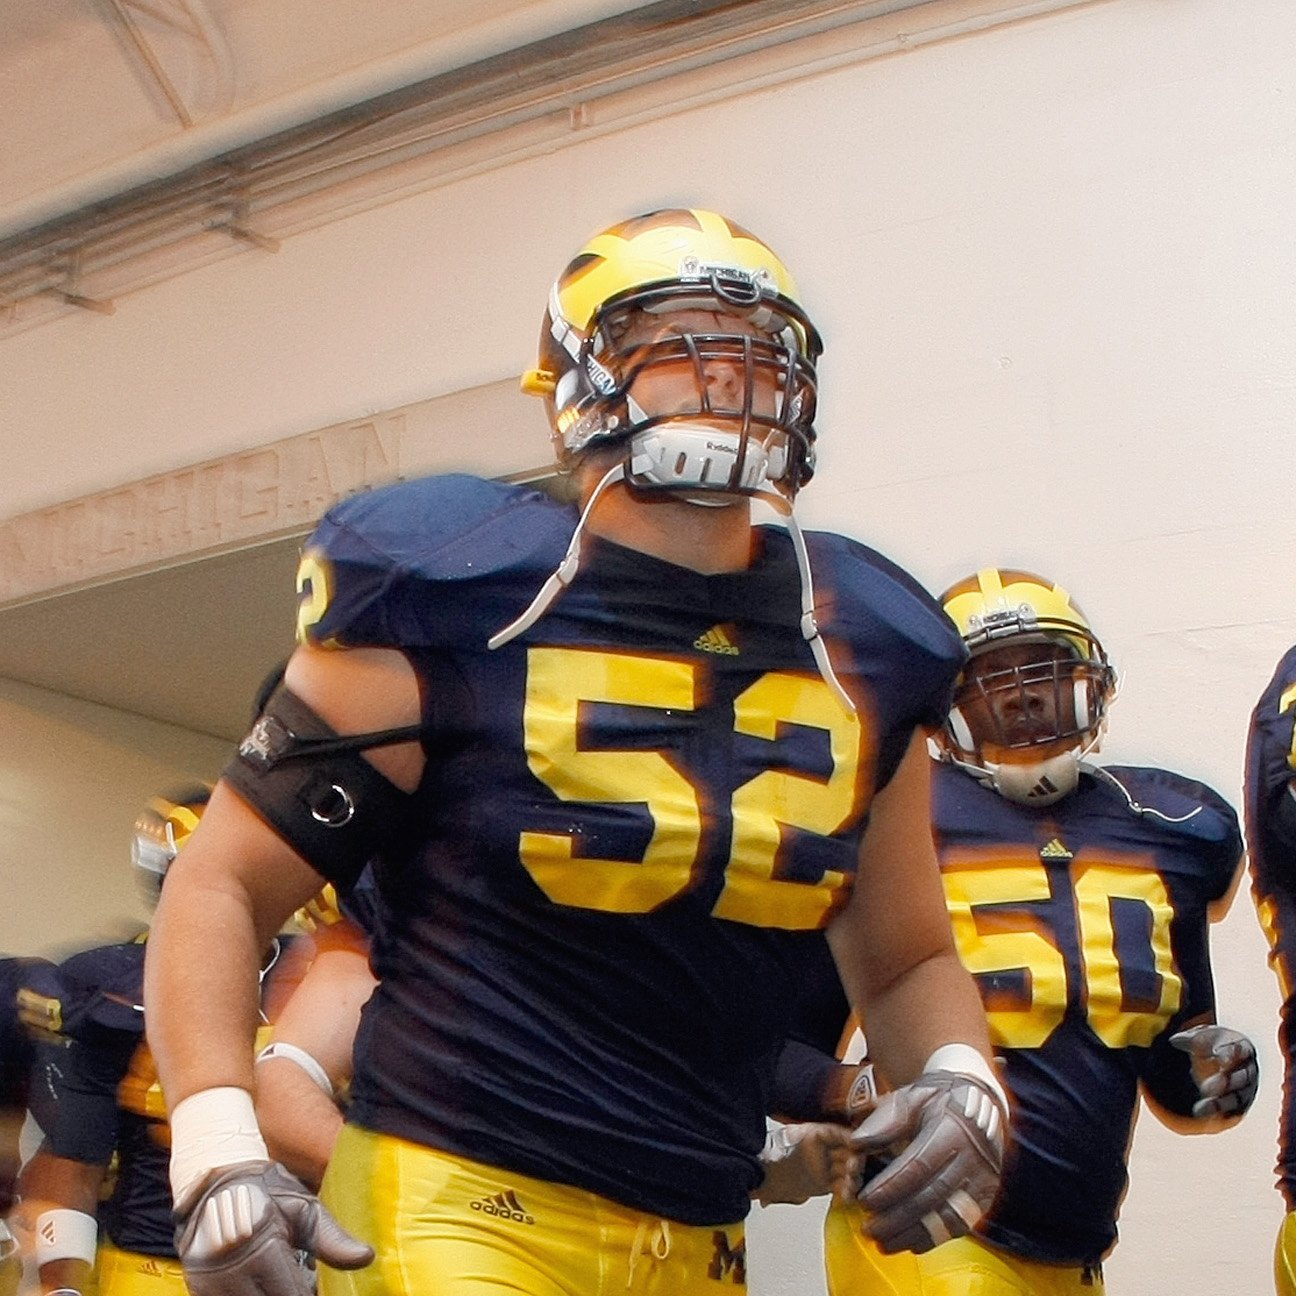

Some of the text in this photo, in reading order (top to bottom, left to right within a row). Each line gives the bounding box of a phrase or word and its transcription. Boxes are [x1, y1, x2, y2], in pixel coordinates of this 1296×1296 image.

[693, 640, 740, 656] adidas
[519, 647, 861, 931] 52
[941, 866, 1182, 1049] 50
[469, 1199, 536, 1226] adidas
[707, 1230, 746, 1285] M
